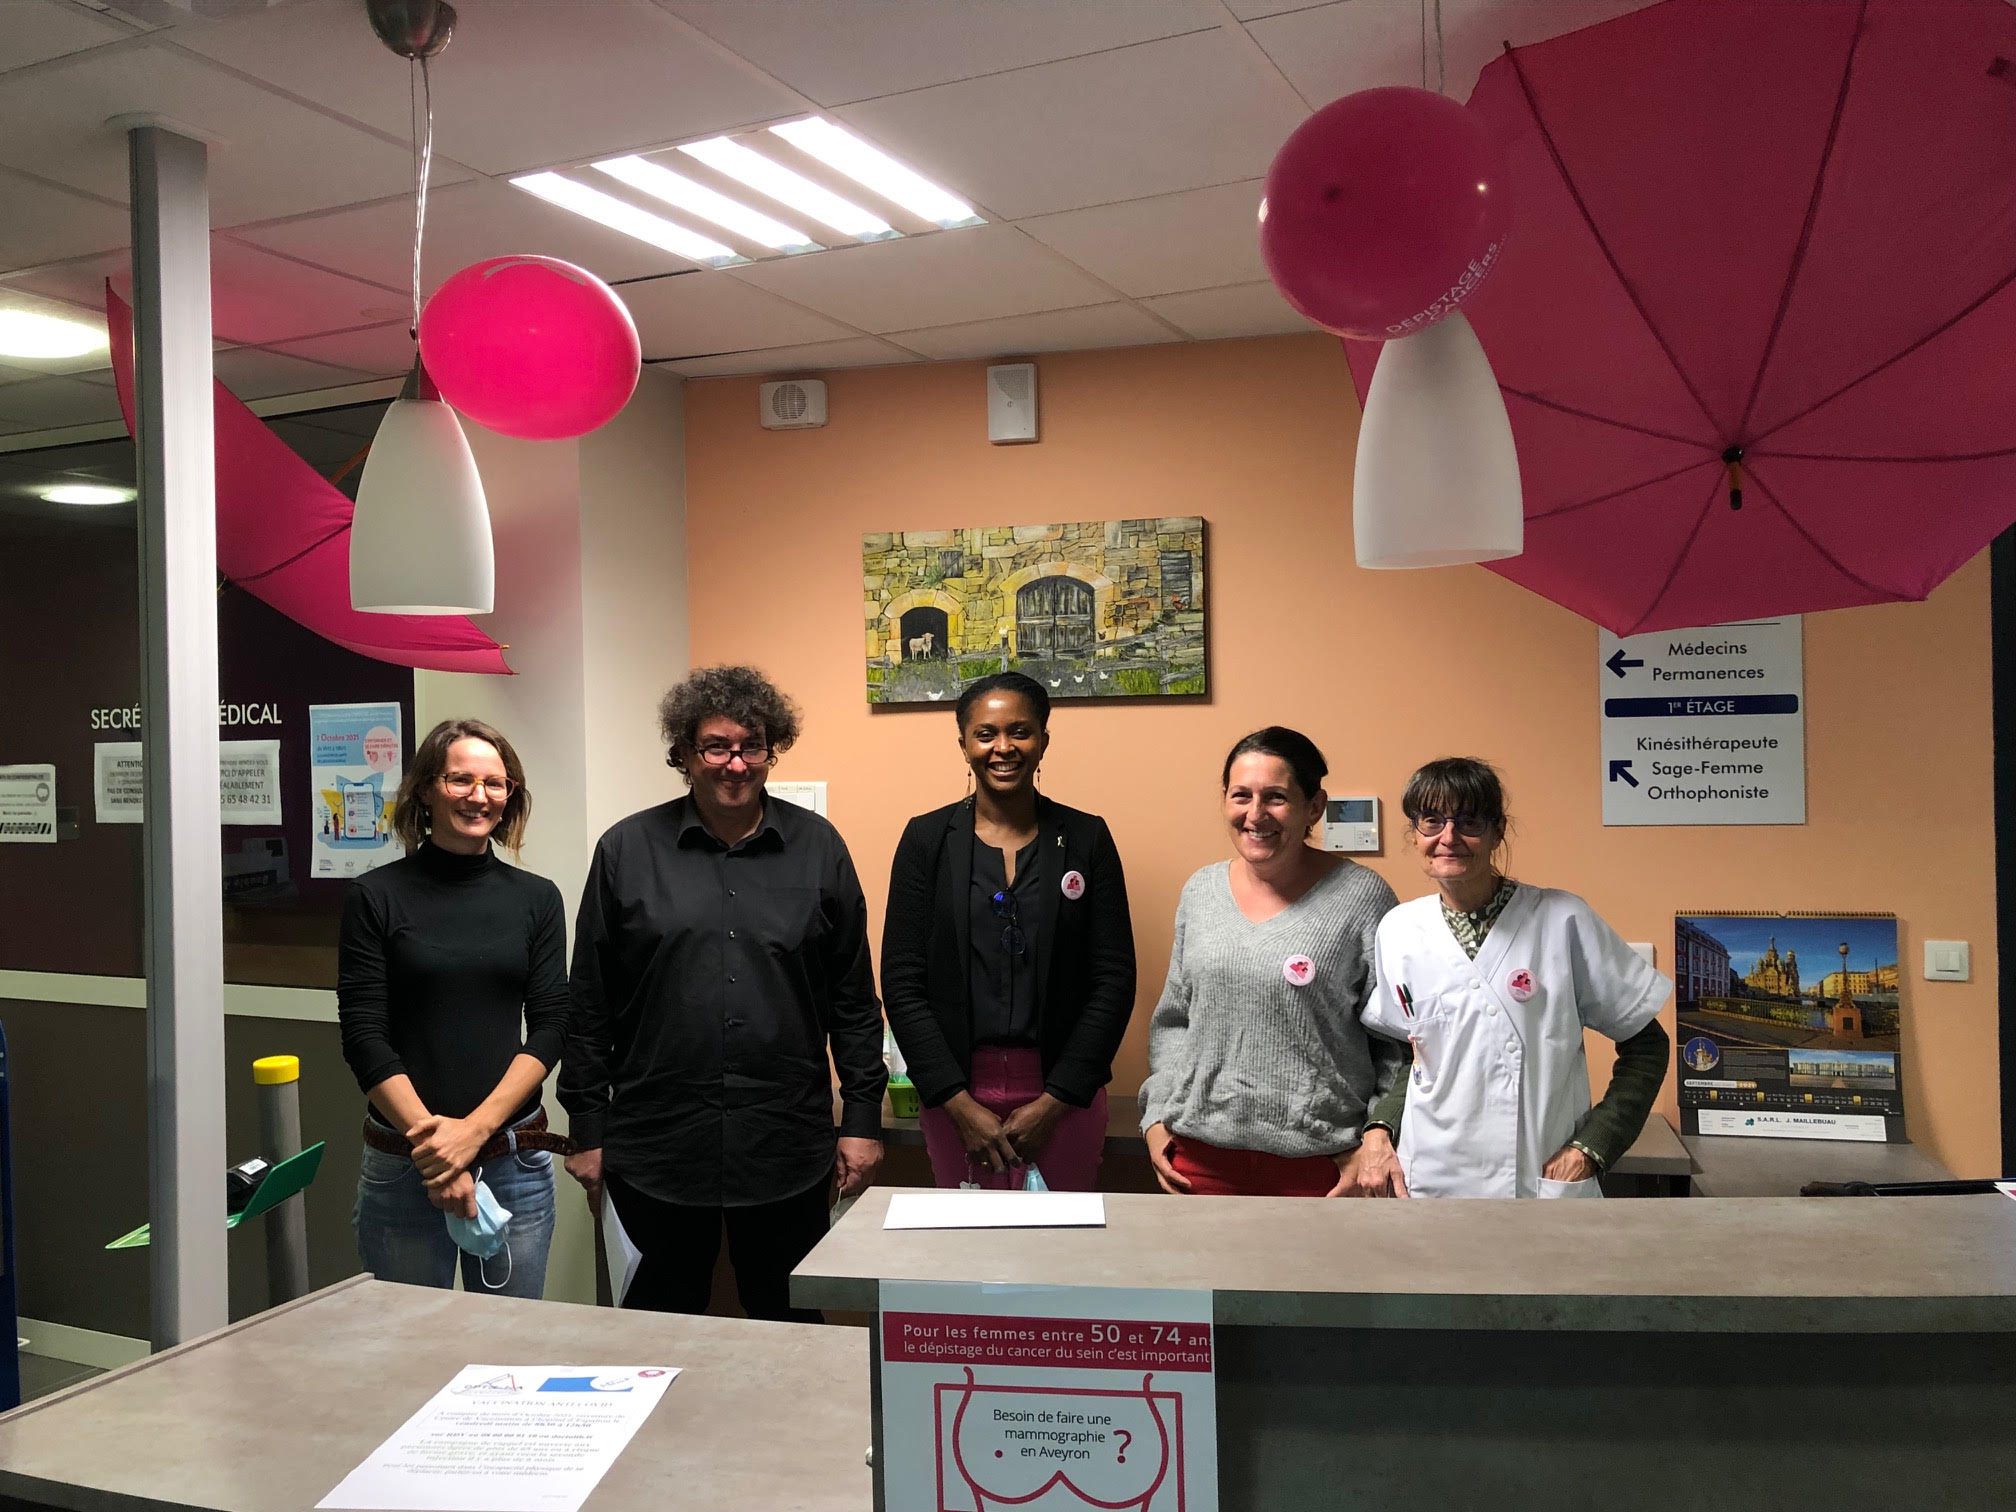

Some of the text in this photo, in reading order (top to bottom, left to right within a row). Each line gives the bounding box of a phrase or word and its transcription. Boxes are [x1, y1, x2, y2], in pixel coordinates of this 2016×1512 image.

[1386, 258, 1480, 333] DEPISTAGE
[1668, 641, 1748, 656] Médecins
[1652, 667, 1765, 681] Permanences
[1686, 699, 1736, 713] ÉTAGE
[1636, 736, 1779, 752] Kinésithérapeute
[1652, 761, 1764, 778] Sage-Femme
[226, 794, 237, 804] 65
[238, 794, 248, 804] 48
[249, 794, 260, 804] 42
[261, 794, 271, 804] 31
[1647, 785, 1769, 802] Orthophoniste
[903, 1324, 939, 1338] Pour
[945, 1325, 967, 1339] les
[973, 1326, 1036, 1341] femmes
[1041, 1330, 1084, 1342] entre
[1090, 1324, 1121, 1343] 50
[1128, 1333, 1144, 1344] et
[1150, 1326, 1181, 1345] 74
[904, 1341, 1210, 1365] le dépistage du cancer du sein c'est important
[993, 1409, 1112, 1425] Besoin de faire une
[1005, 1429, 1132, 1464] mammographie ?
[1020, 1446, 1090, 1462] en Aveyron
